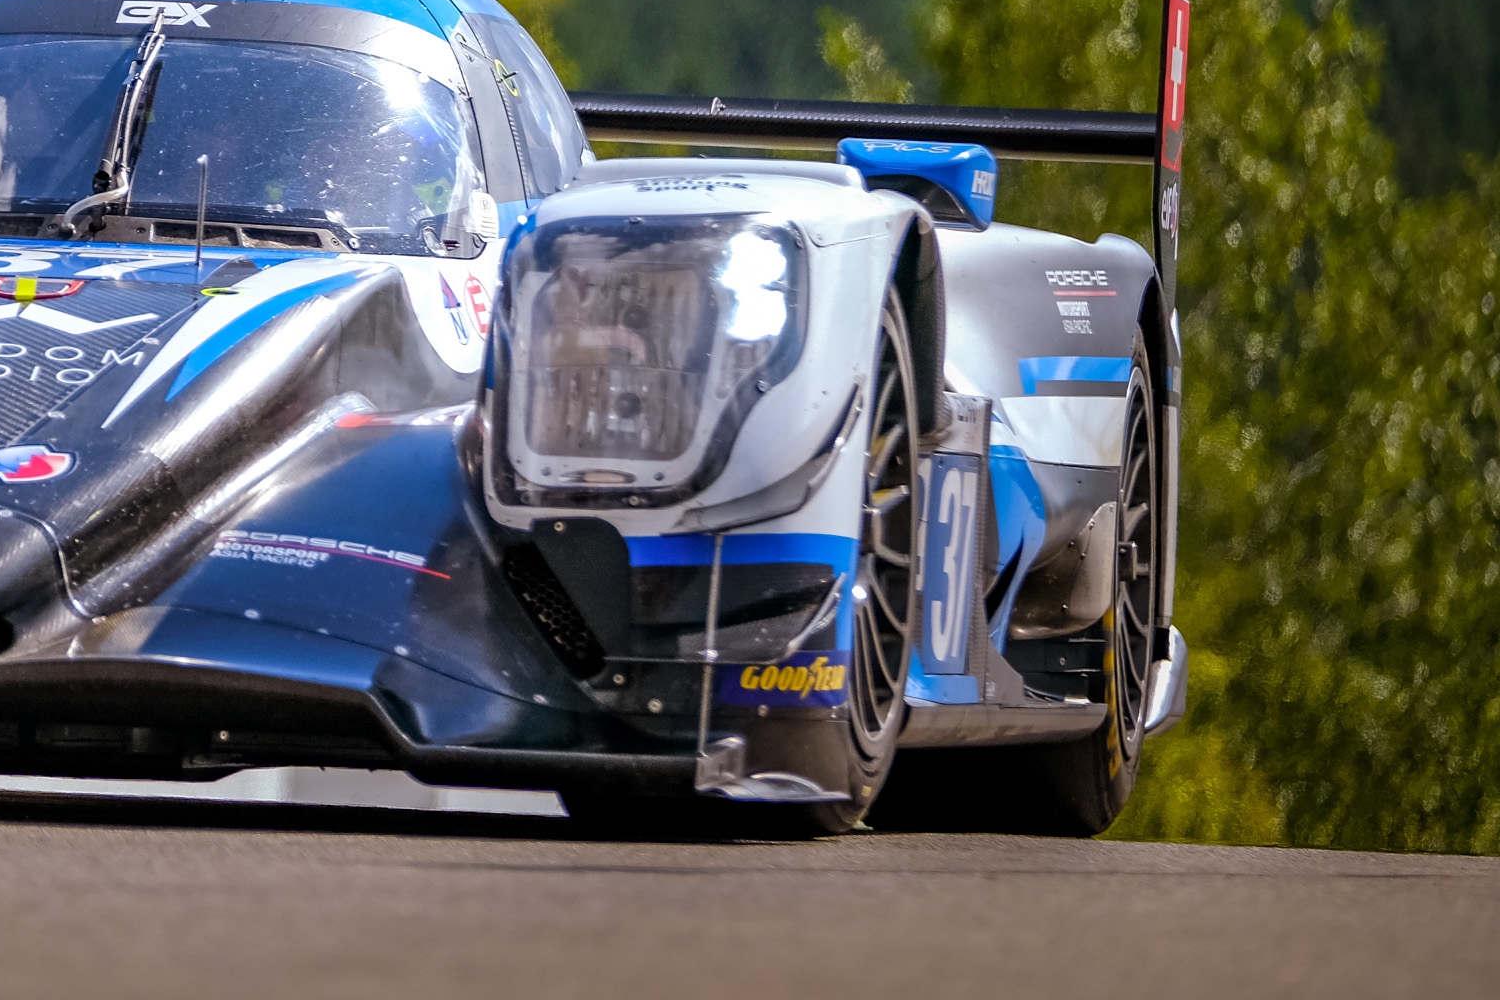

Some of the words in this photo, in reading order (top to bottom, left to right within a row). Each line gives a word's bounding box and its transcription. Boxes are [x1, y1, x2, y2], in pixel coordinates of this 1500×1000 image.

[863, 141, 951, 153] Plus
[1045, 270, 1108, 286] PORSCHE
[213, 541, 330, 562] MOTORSPORT
[219, 529, 427, 567] PORSCHE
[209, 549, 248, 561] ASIA
[253, 551, 316, 568] PACIFIC
[931, 467, 978, 662] 37
